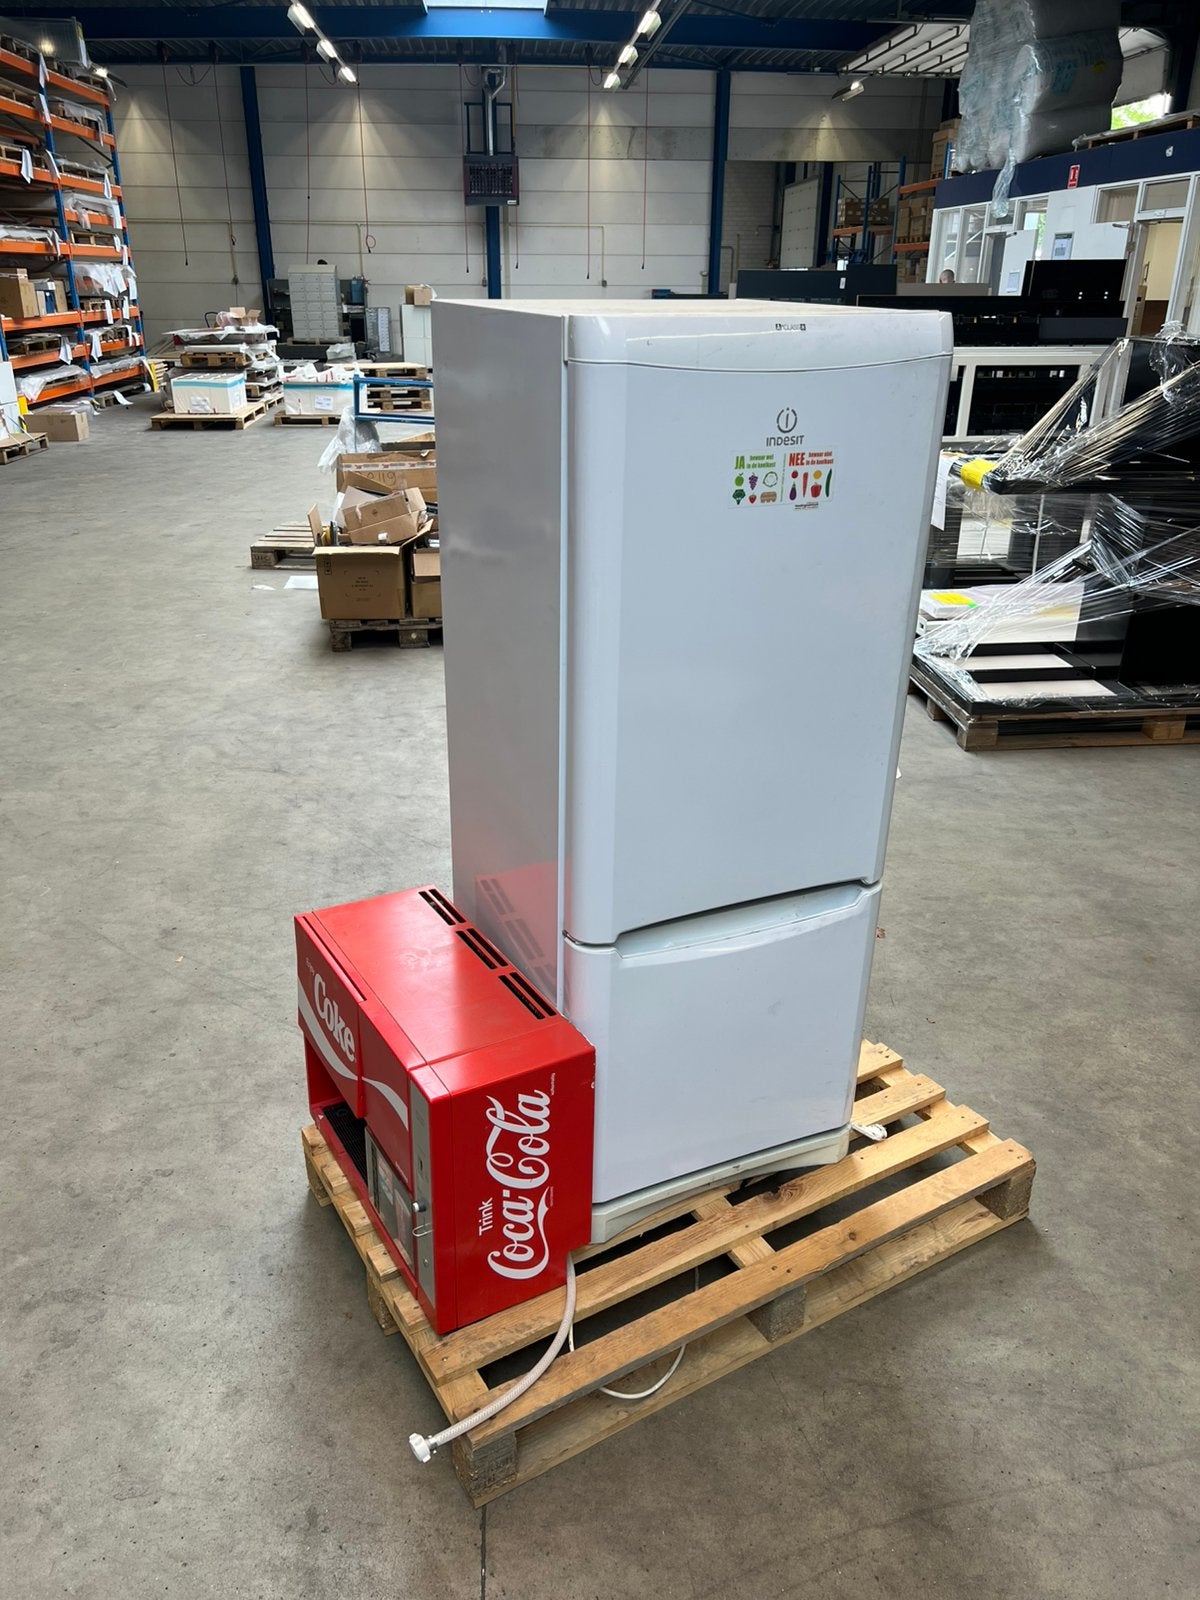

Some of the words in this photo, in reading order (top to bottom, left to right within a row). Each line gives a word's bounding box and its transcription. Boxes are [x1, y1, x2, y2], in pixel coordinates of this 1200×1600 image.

[766, 435, 804, 447] INDESIT
[735, 455, 745, 470] JA
[789, 452, 806, 467] NEE
[314, 973, 356, 1062] Coke
[485, 1089, 551, 1280] Coca-Cola
[479, 1197, 493, 1236] Trink
